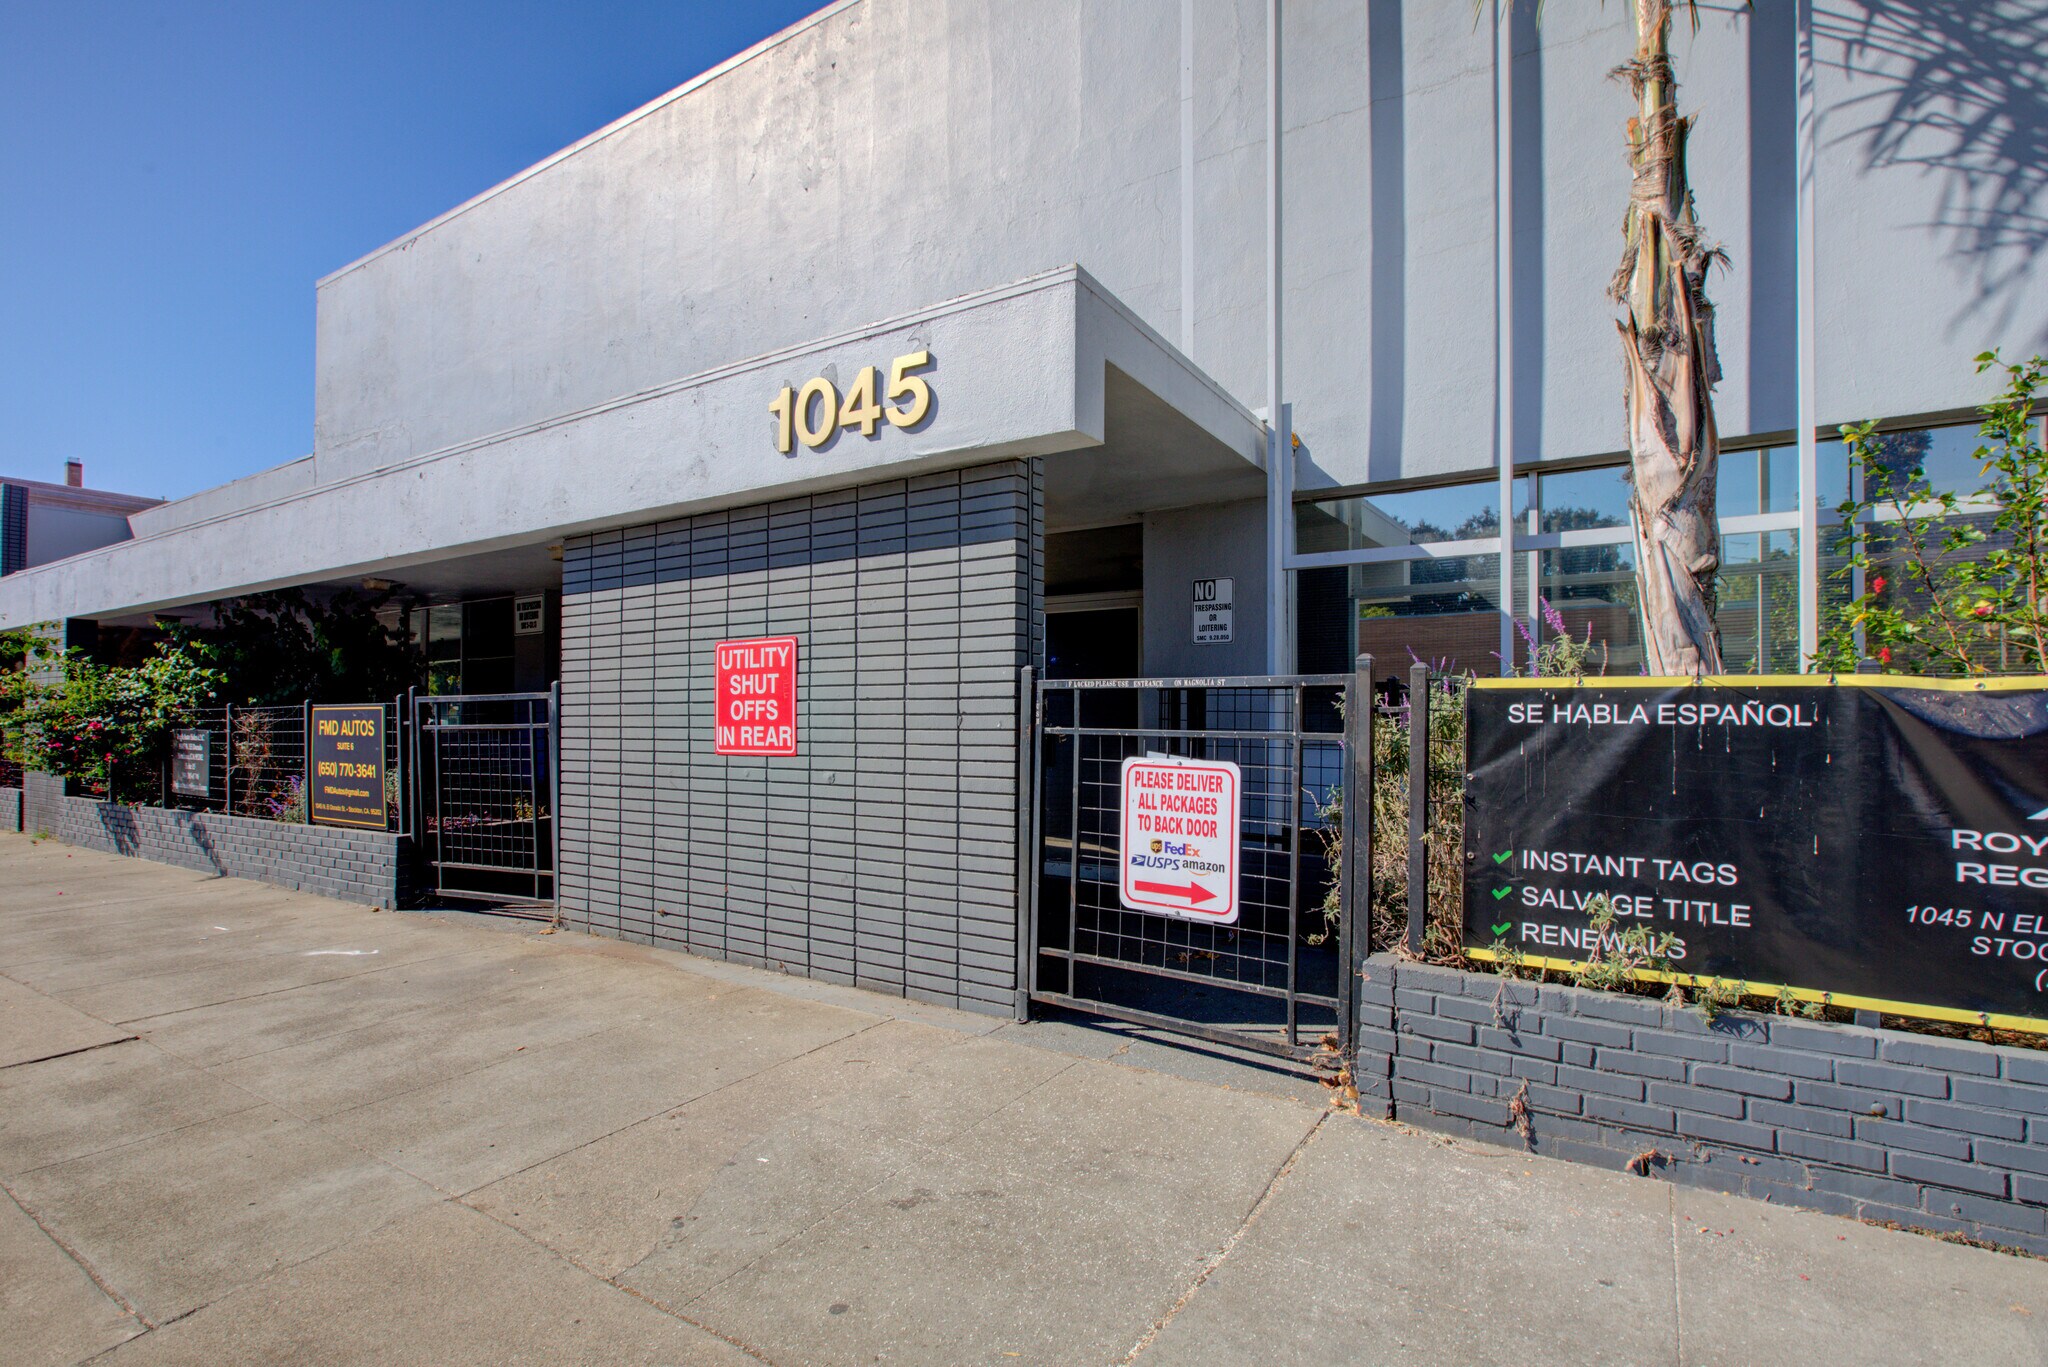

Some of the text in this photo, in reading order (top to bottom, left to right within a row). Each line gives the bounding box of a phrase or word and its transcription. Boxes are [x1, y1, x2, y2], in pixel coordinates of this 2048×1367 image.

[768, 350, 930, 454] 1045
[1194, 580, 1215, 600] NO
[1195, 603, 1232, 612] TRESPASSING
[722, 646, 790, 670] UTILITY
[730, 674, 779, 695] SHUT
[730, 700, 778, 720] OFFS
[1508, 700, 1812, 726] SE HABLA ESPAÑOL
[318, 720, 375, 736] FMD AUTOS
[719, 726, 792, 746] IN REAR
[337, 742, 350, 750] SUITE
[318, 762, 376, 778] (650) 770-3641
[1135, 771, 1223, 793] PLEASE DELIVER
[1138, 793, 1217, 815] ALL PACKAGES
[1138, 814, 1217, 838] TO BACK DOOR
[1165, 841, 1200, 858] FedEx
[1147, 856, 1225, 873] USPS amazon
[1523, 850, 1738, 886] INSTANT TAGS
[1663, 898, 1750, 927] TITLE
[1906, 905, 2048, 934] 1045 N EL
